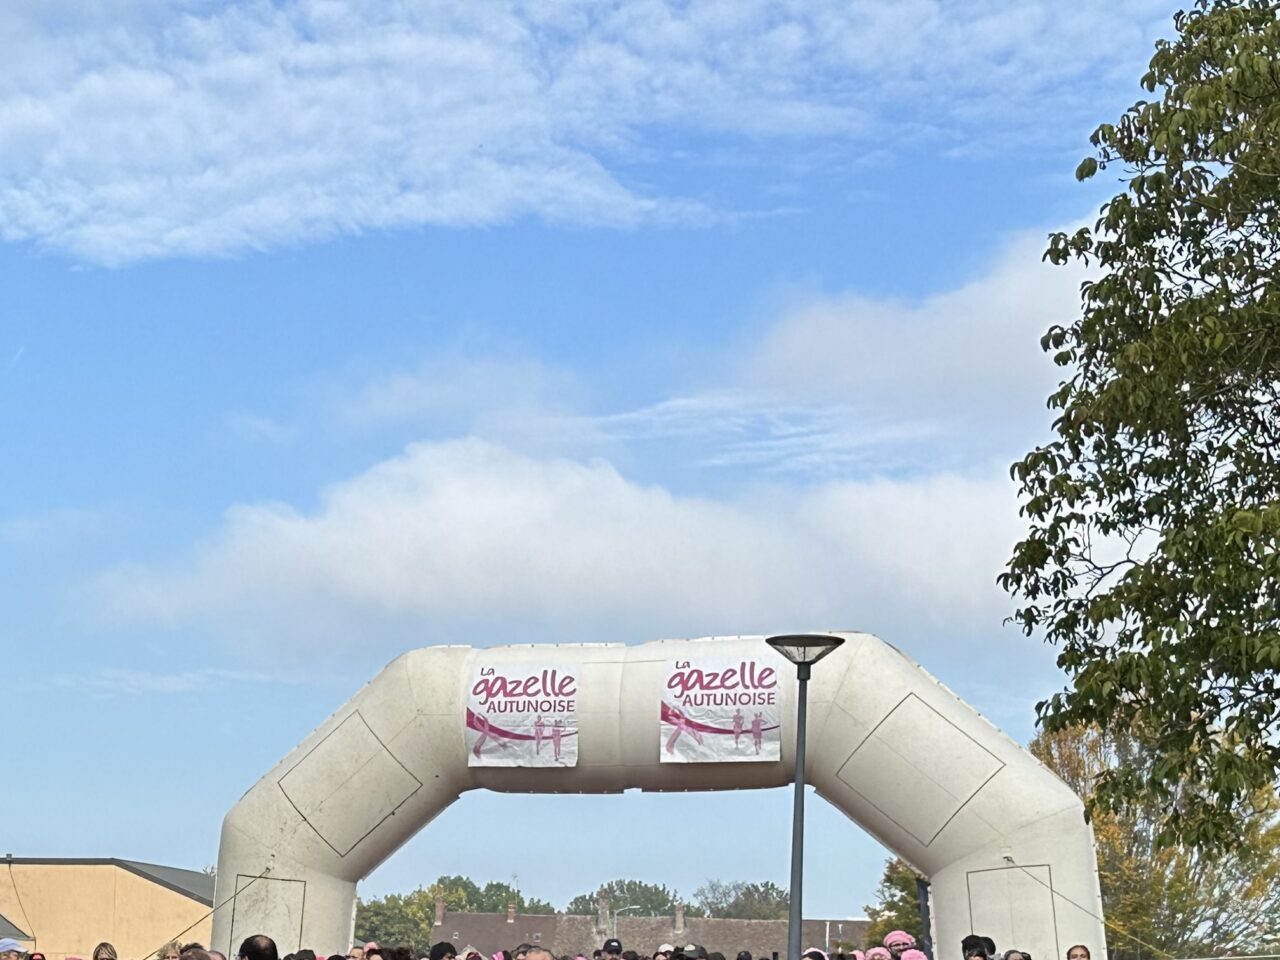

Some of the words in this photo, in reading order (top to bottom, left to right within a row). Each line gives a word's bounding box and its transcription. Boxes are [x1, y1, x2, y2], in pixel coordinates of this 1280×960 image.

[480, 667, 495, 676] La
[676, 661, 691, 670] La
[472, 669, 577, 705] gazelle
[667, 661, 778, 699] gazelle
[486, 699, 575, 713] AUTUNOISE
[682, 692, 776, 707] AUTUNOISE
